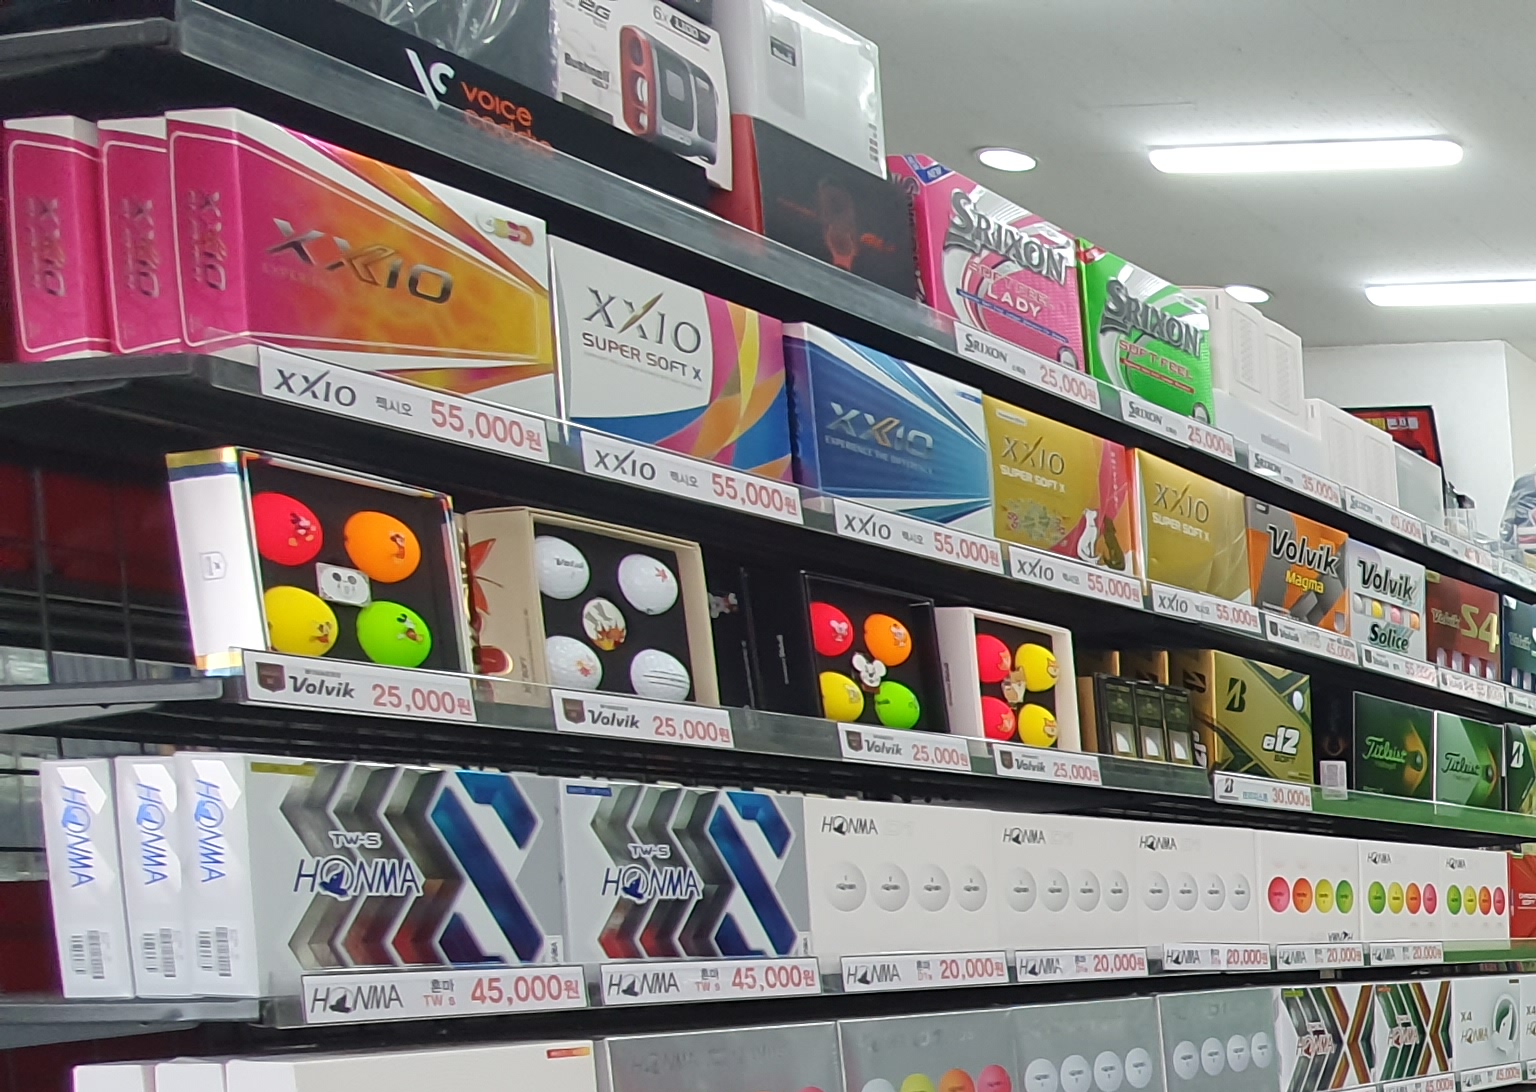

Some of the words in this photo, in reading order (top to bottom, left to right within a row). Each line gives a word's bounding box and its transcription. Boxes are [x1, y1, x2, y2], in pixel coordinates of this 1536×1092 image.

[944, 188, 1068, 286] SRIXON
[264, 217, 454, 305] XXIO
[988, 282, 1043, 319] LADY
[1102, 276, 1201, 358] SRIXON
[581, 286, 702, 356] XXIO
[581, 331, 642, 363] SUPER
[644, 349, 688, 378] SOFT
[688, 366, 703, 383] X
[964, 333, 1008, 363] SRIXON
[1040, 364, 1097, 405] 25,000원
[1119, 340, 1157, 367] SOFT
[1159, 354, 1195, 381] FEEL
[273, 367, 357, 408] XXIO
[429, 400, 543, 454] 55,000원
[826, 400, 935, 459] XXIO
[1128, 401, 1163, 426] SRIXON
[1188, 424, 1233, 457] 25,000원
[1002, 435, 1065, 477] XXIO
[594, 449, 656, 482] XXIO
[710, 473, 798, 516] 55,000원
[1153, 482, 1210, 524] XXIO
[842, 513, 892, 541] XXIO
[933, 533, 1000, 567] 55,000원
[1268, 525, 1341, 579] Volvik
[1017, 557, 1054, 581] XXIO
[1087, 573, 1140, 602] 55,000원
[1285, 569, 1325, 595] Magma
[1357, 559, 1417, 602] Volvik
[1158, 591, 1188, 613] XXIO
[1216, 604, 1258, 629] 55,000원
[1460, 604, 1498, 653] S4
[1368, 623, 1409, 653] Solice
[288, 675, 356, 700] Volvik
[371, 683, 473, 717] 25,000원
[587, 707, 640, 731] Volvik
[652, 715, 731, 744] 25,000원
[1262, 725, 1300, 756] e12
[864, 737, 903, 757] Volvik
[911, 744, 969, 767] 25,000원
[1015, 756, 1046, 774] Volvik
[1053, 762, 1100, 782] 25,000원
[1272, 787, 1310, 807] 30,000원
[62, 784, 95, 888] HONMA
[136, 782, 169, 885] HONMA
[194, 778, 227, 882] HONMA
[329, 831, 382, 849] TW-S
[821, 815, 879, 836] HONMA
[1003, 827, 1046, 845] HONMA
[1139, 835, 1177, 851] HONMA
[628, 842, 671, 860] TW-S
[1367, 850, 1392, 865] HONMA
[293, 856, 426, 900] HONMA
[601, 866, 702, 901] HONMA
[847, 963, 901, 986] HONMA
[939, 957, 1005, 980] 20,000원
[1019, 956, 1063, 977] HONMA
[1093, 953, 1146, 973] 20,000원
[1226, 948, 1269, 967] 20,000원
[1327, 946, 1362, 963] 20,000원
[1413, 944, 1442, 961] 20,000원
[311, 985, 404, 1014] HONMA
[430, 979, 455, 994] 혼마
[471, 975, 579, 1006] 45,000원
[608, 970, 680, 997] HONMA
[732, 966, 816, 991] 45,000원
